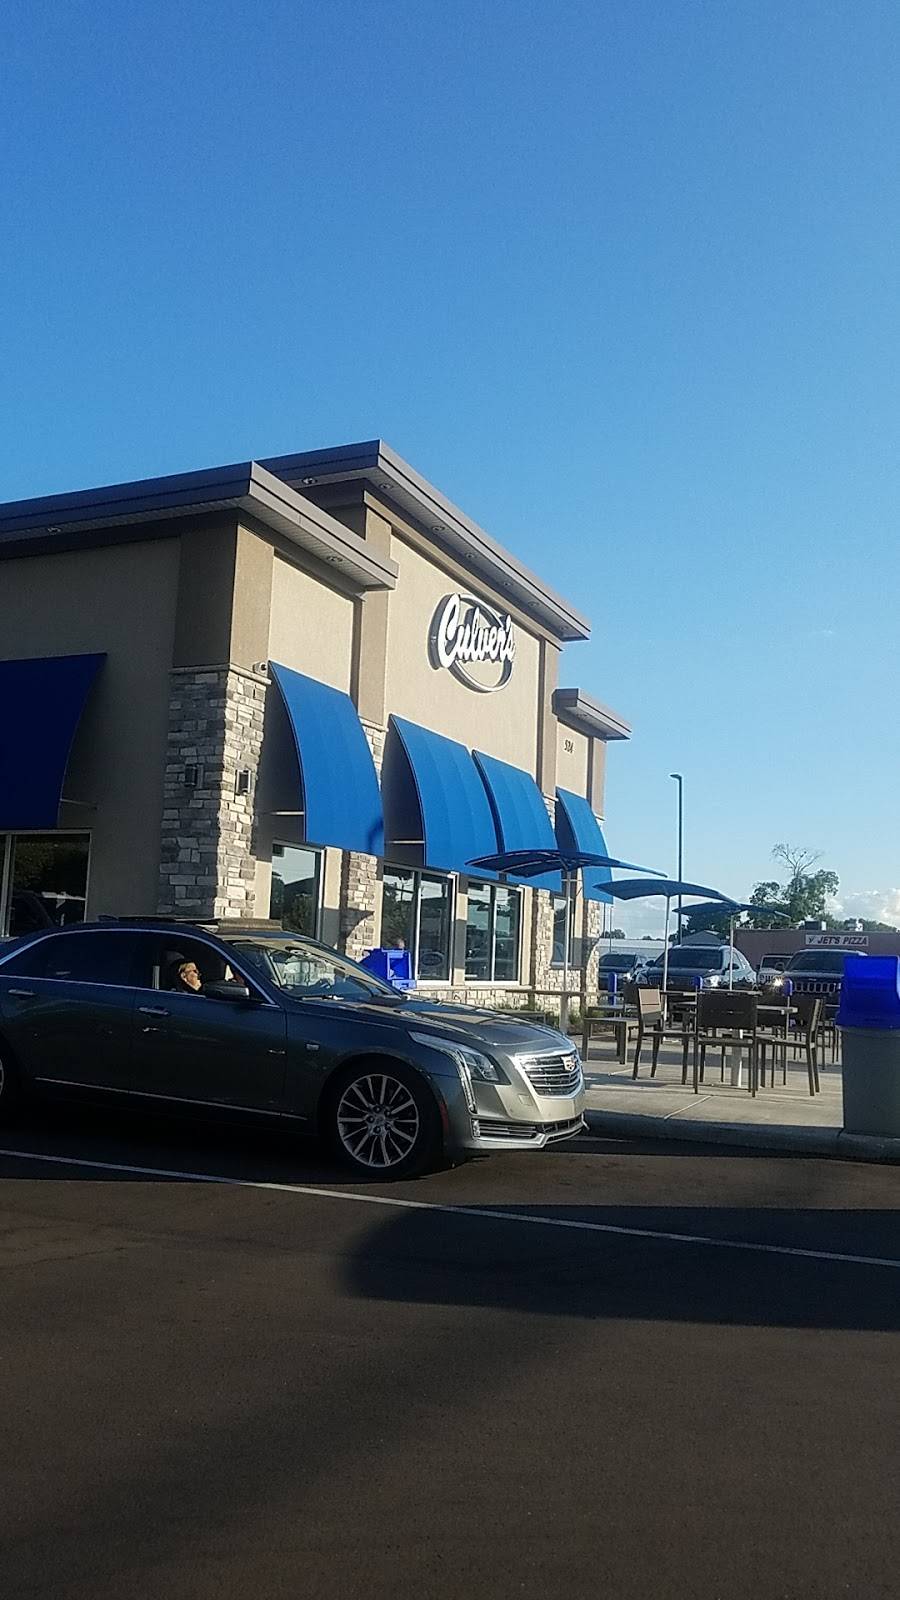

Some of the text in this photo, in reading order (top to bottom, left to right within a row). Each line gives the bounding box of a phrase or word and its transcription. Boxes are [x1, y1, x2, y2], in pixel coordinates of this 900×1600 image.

[437, 593, 516, 668] Culver's
[817, 936, 867, 945] JET'S PIZZA
